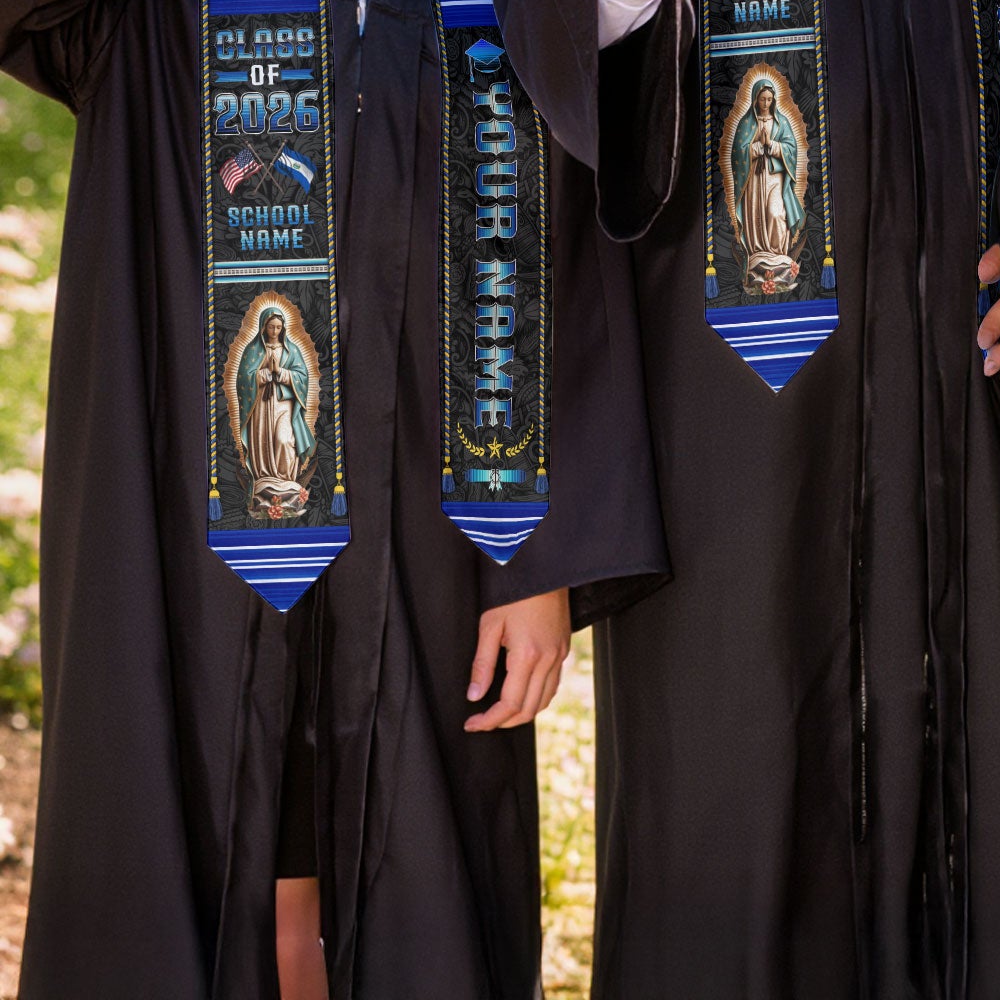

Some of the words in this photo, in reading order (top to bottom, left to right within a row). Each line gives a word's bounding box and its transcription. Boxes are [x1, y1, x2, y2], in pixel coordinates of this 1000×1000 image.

[215, 27, 316, 60] CLASS
[250, 63, 280, 86] OF
[213, 89, 320, 136] 2026
[471, 79, 518, 243] YOUR
[227, 204, 315, 228] SCHOOL
[240, 228, 304, 250] NAME
[473, 258, 517, 430] NAME
